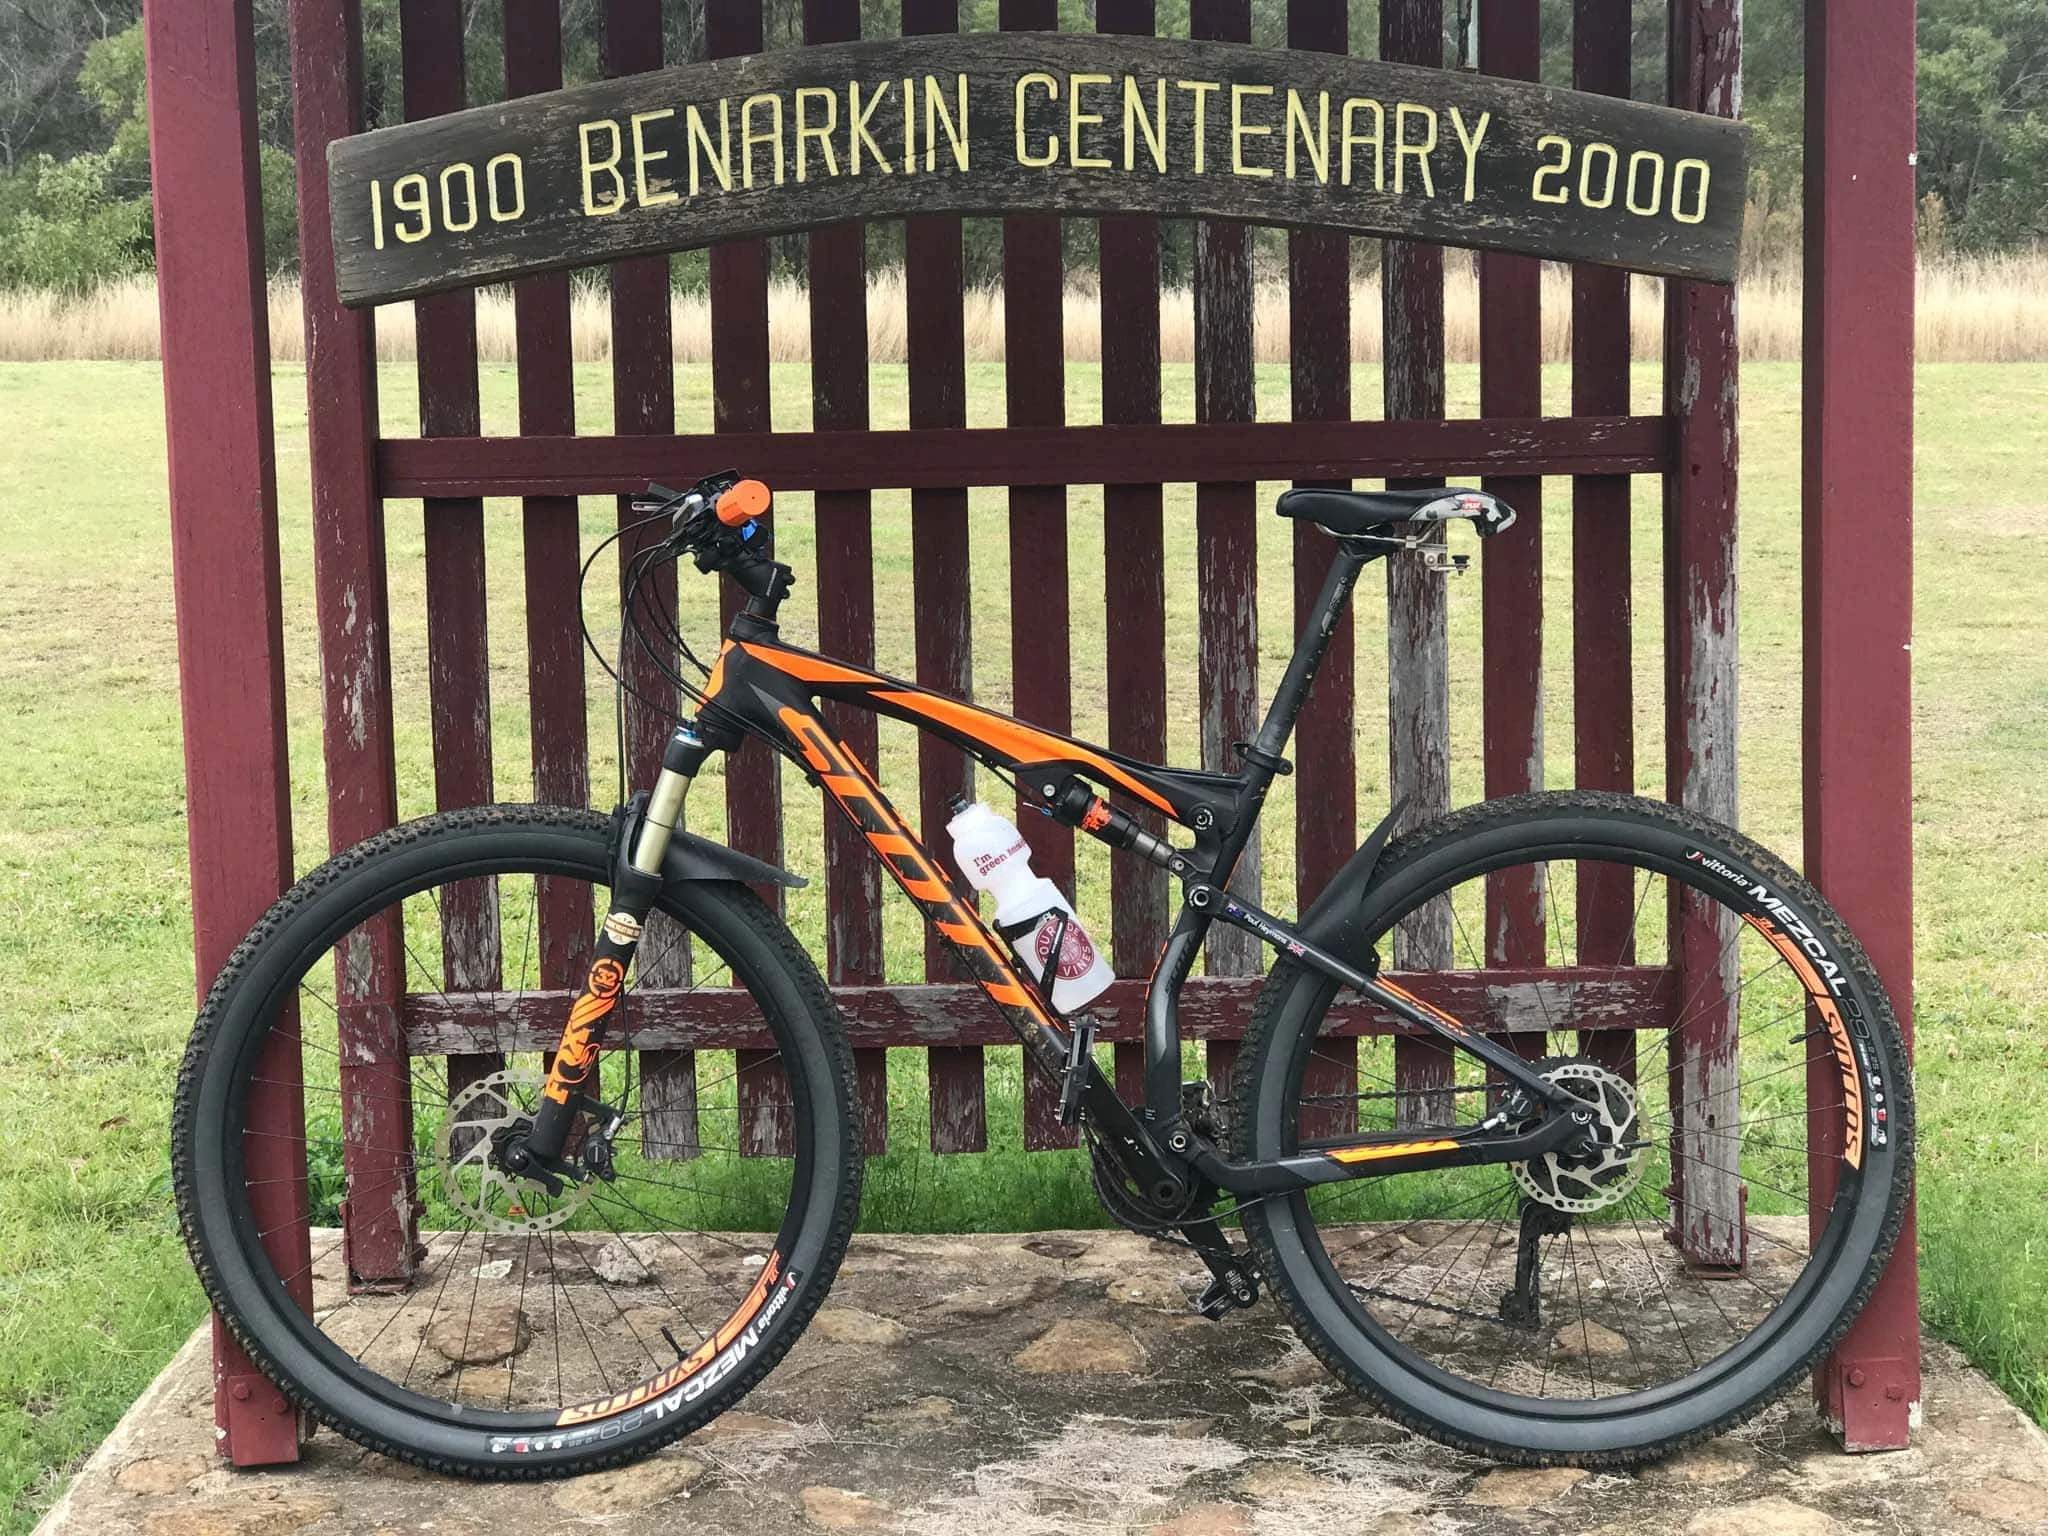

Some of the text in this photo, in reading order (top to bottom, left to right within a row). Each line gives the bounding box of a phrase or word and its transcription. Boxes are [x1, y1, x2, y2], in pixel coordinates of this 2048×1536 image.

[371, 73, 1711, 251] 1900 BENARKIN CENTENARY 2000
[974, 854, 992, 867] I'm
[980, 854, 1008, 876] green
[1701, 857, 1749, 887] vittoria
[1747, 885, 1847, 997] MEZCAL
[1063, 945, 1092, 977] VINES
[763, 1286, 788, 1331] vittoria
[643, 1332, 760, 1420] MEZCAL
